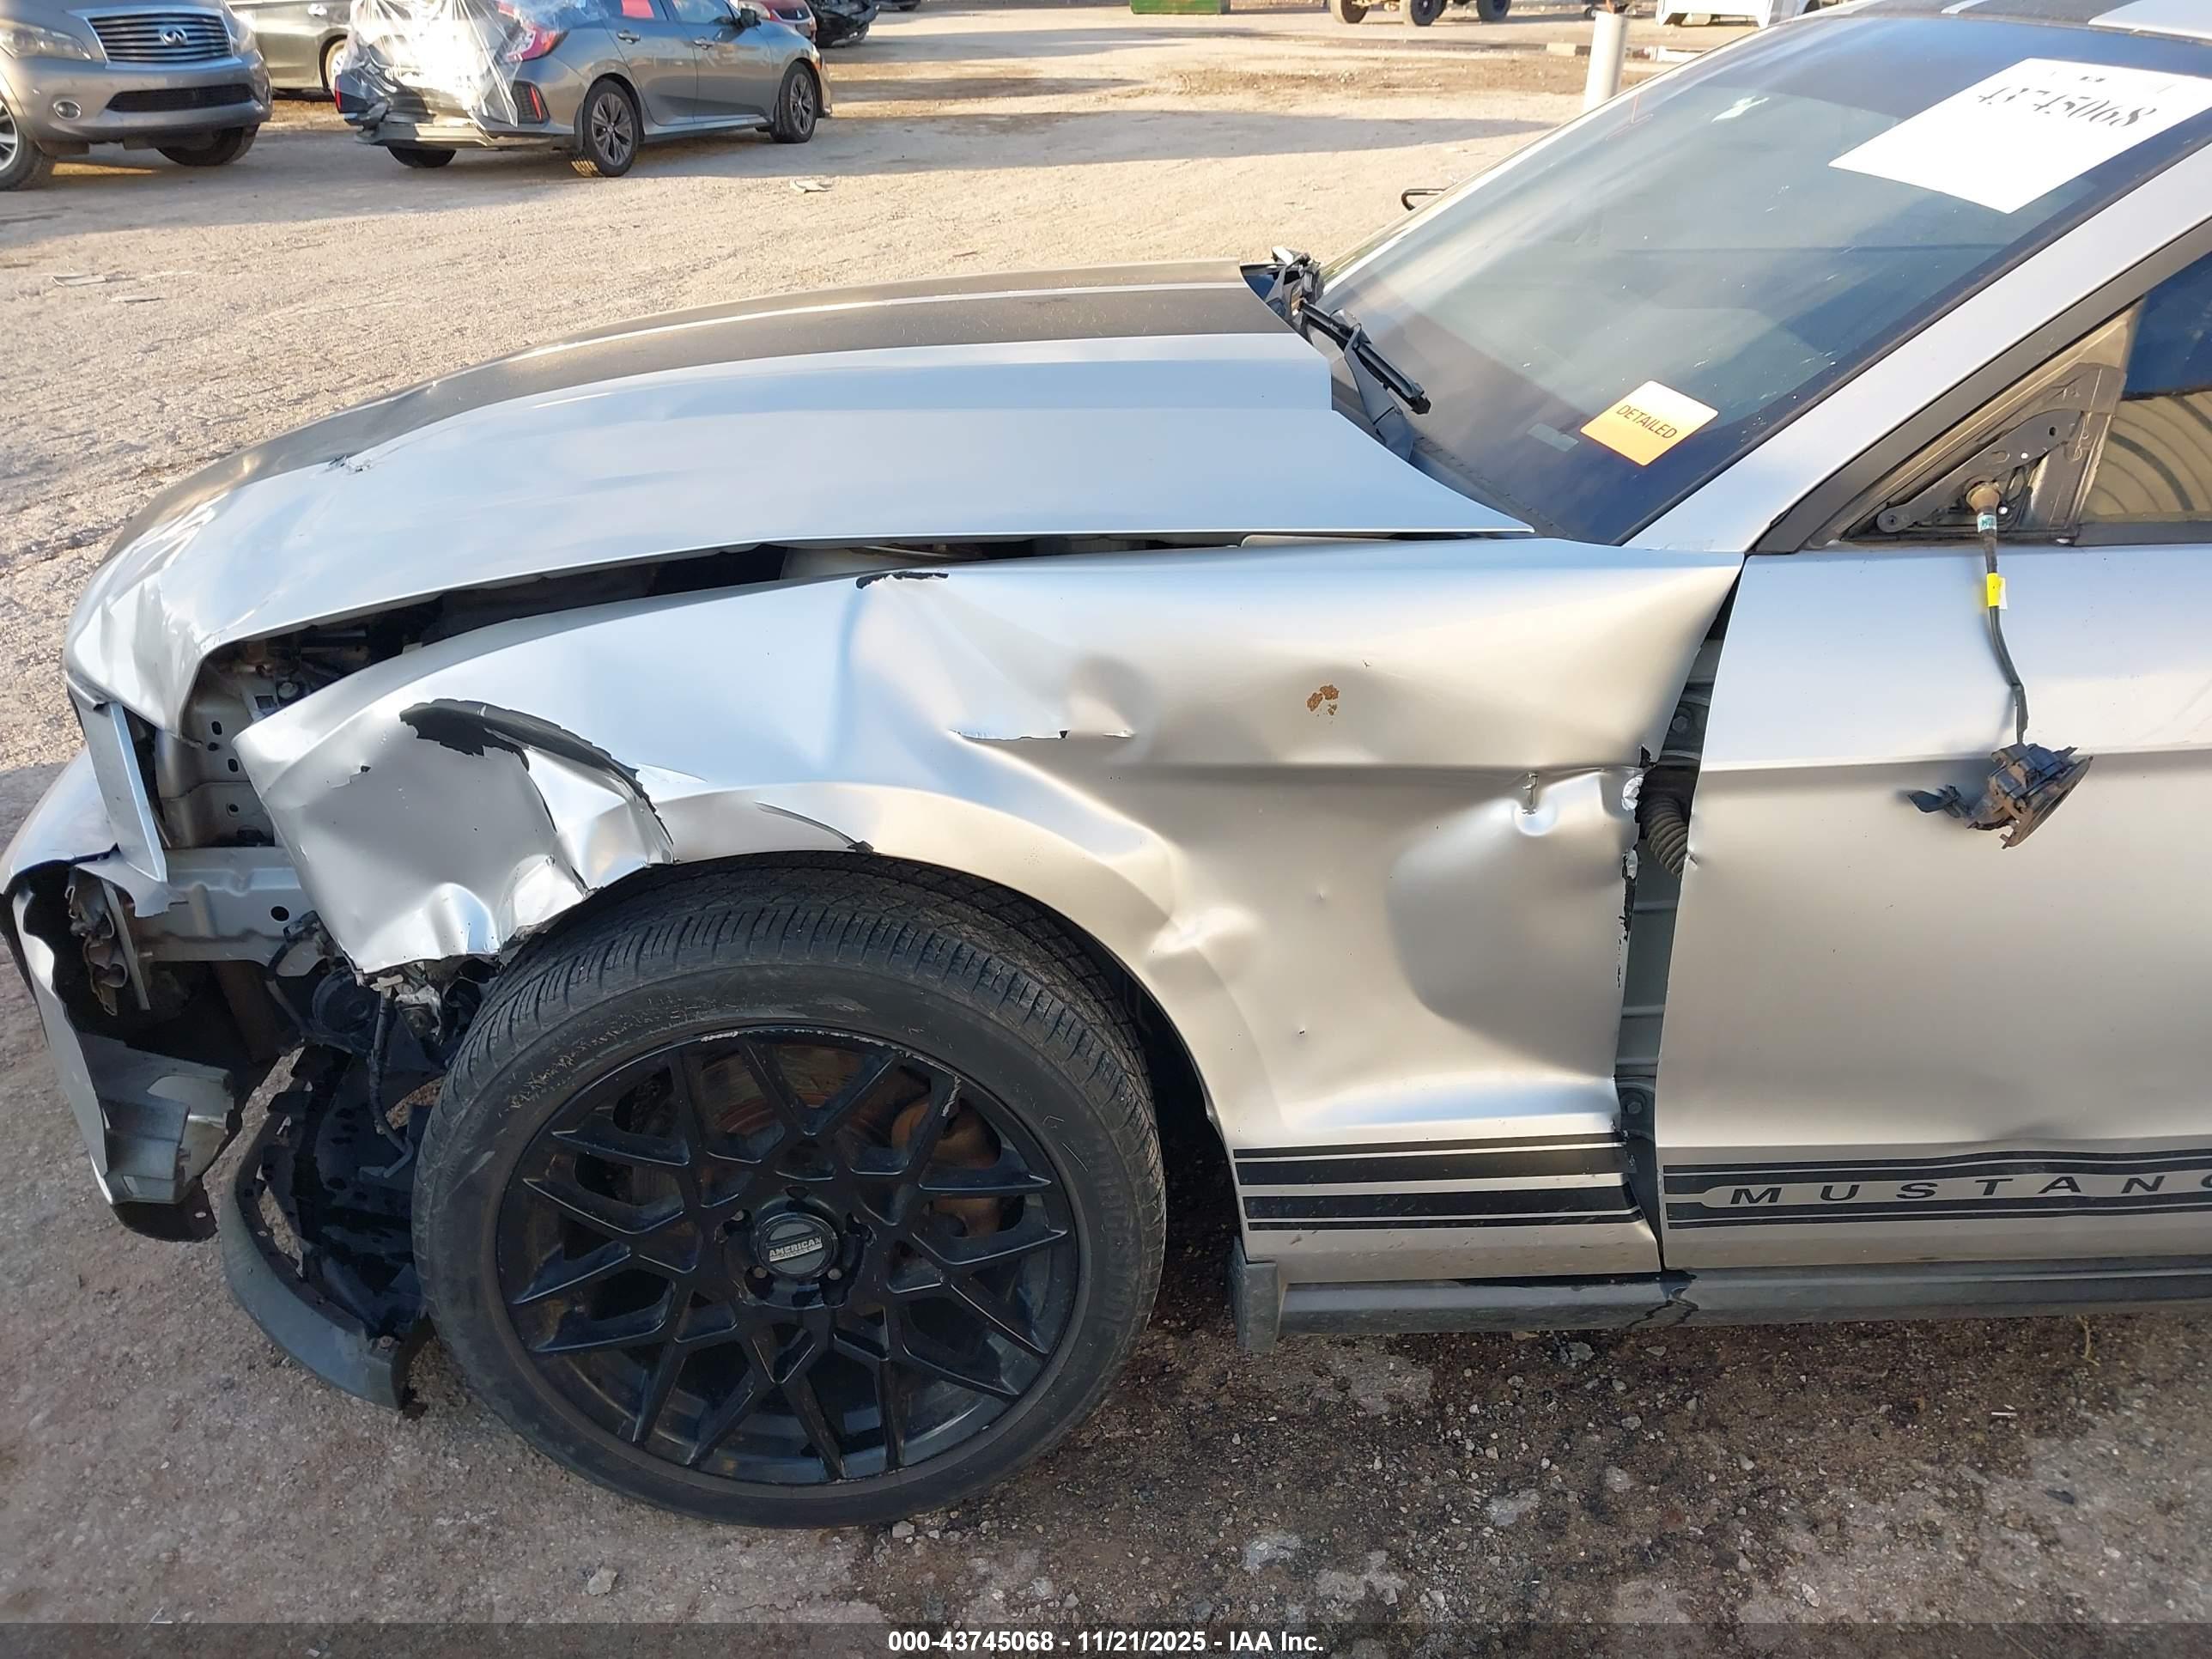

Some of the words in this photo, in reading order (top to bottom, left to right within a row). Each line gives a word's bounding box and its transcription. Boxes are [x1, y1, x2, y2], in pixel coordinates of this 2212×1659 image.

[1616, 404, 1678, 440] DETAILED
[1729, 1174, 2212, 1205] MUSTAN
[769, 1236, 823, 1257] AMERICAN
